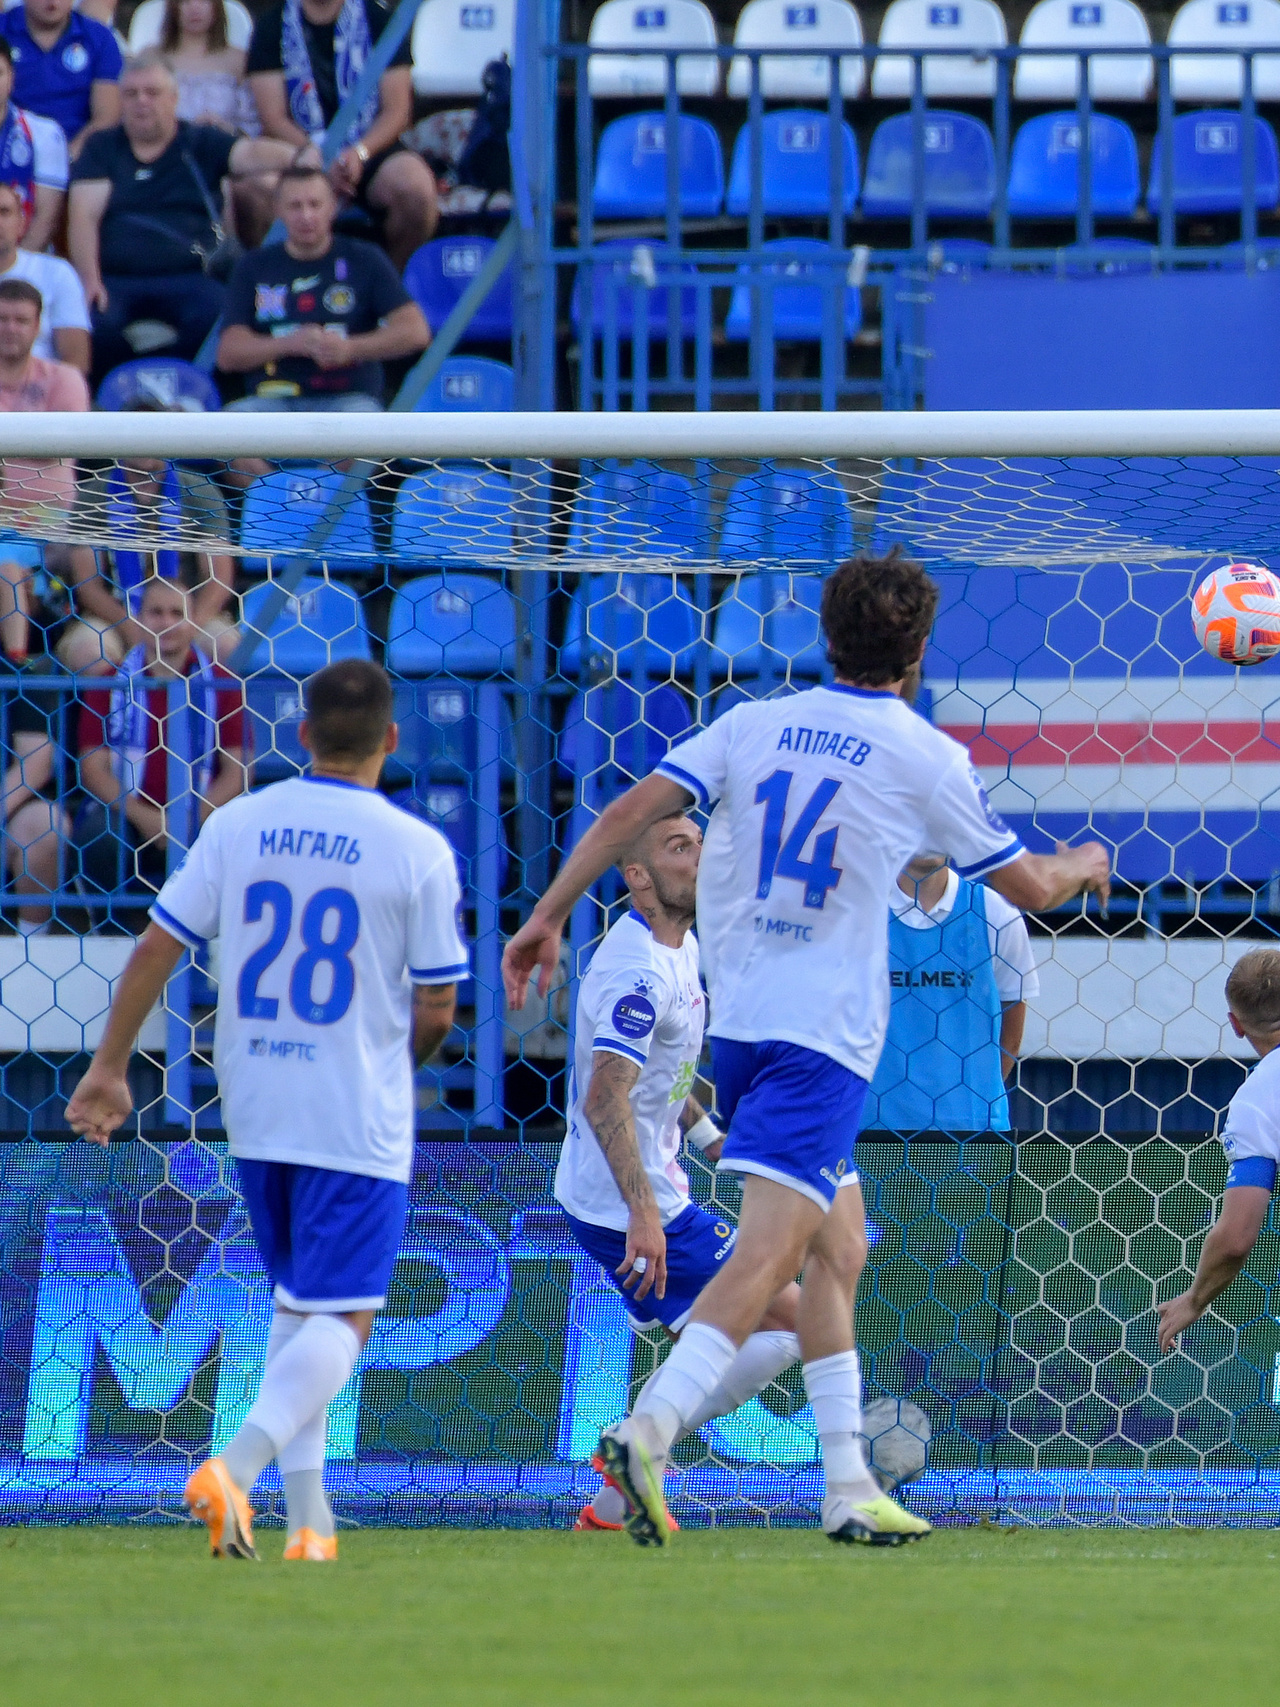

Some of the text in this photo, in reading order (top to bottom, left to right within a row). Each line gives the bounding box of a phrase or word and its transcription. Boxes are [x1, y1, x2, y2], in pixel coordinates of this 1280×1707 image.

[777, 726, 872, 768] АППАЕВ
[259, 827, 362, 866] МАГАЛЬ
[753, 768, 844, 910] 14
[765, 917, 814, 943] МРТС
[236, 878, 361, 1027] 28
[889, 970, 956, 988] ELME
[269, 1040, 318, 1063] МРТС
